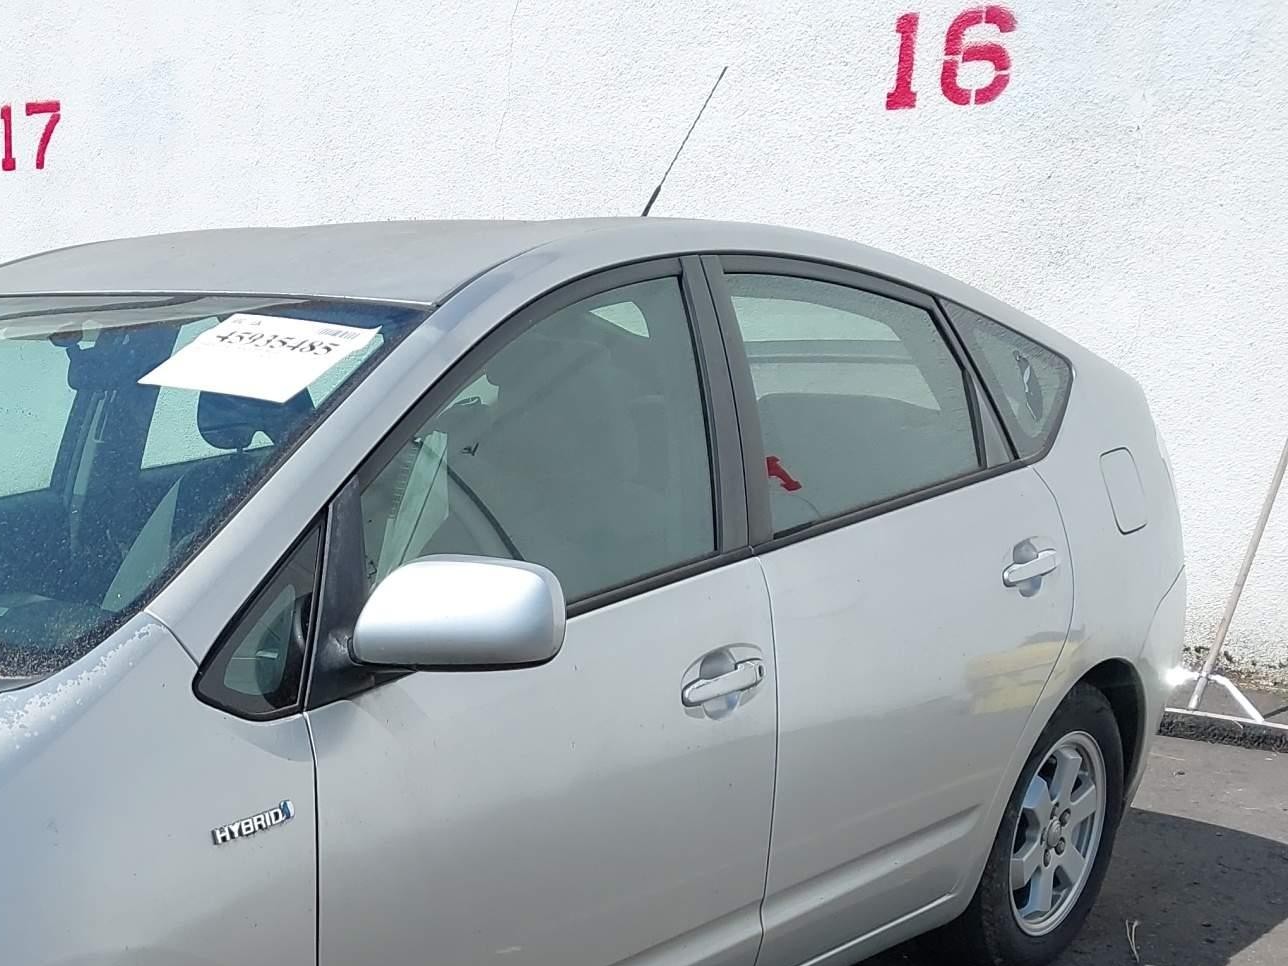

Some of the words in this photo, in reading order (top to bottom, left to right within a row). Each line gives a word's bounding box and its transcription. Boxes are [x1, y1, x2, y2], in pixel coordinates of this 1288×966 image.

[885, 5, 1015, 111] 16
[0, 100, 62, 173] 17
[216, 331, 340, 355] 45935485
[212, 807, 286, 845] HYBRID
